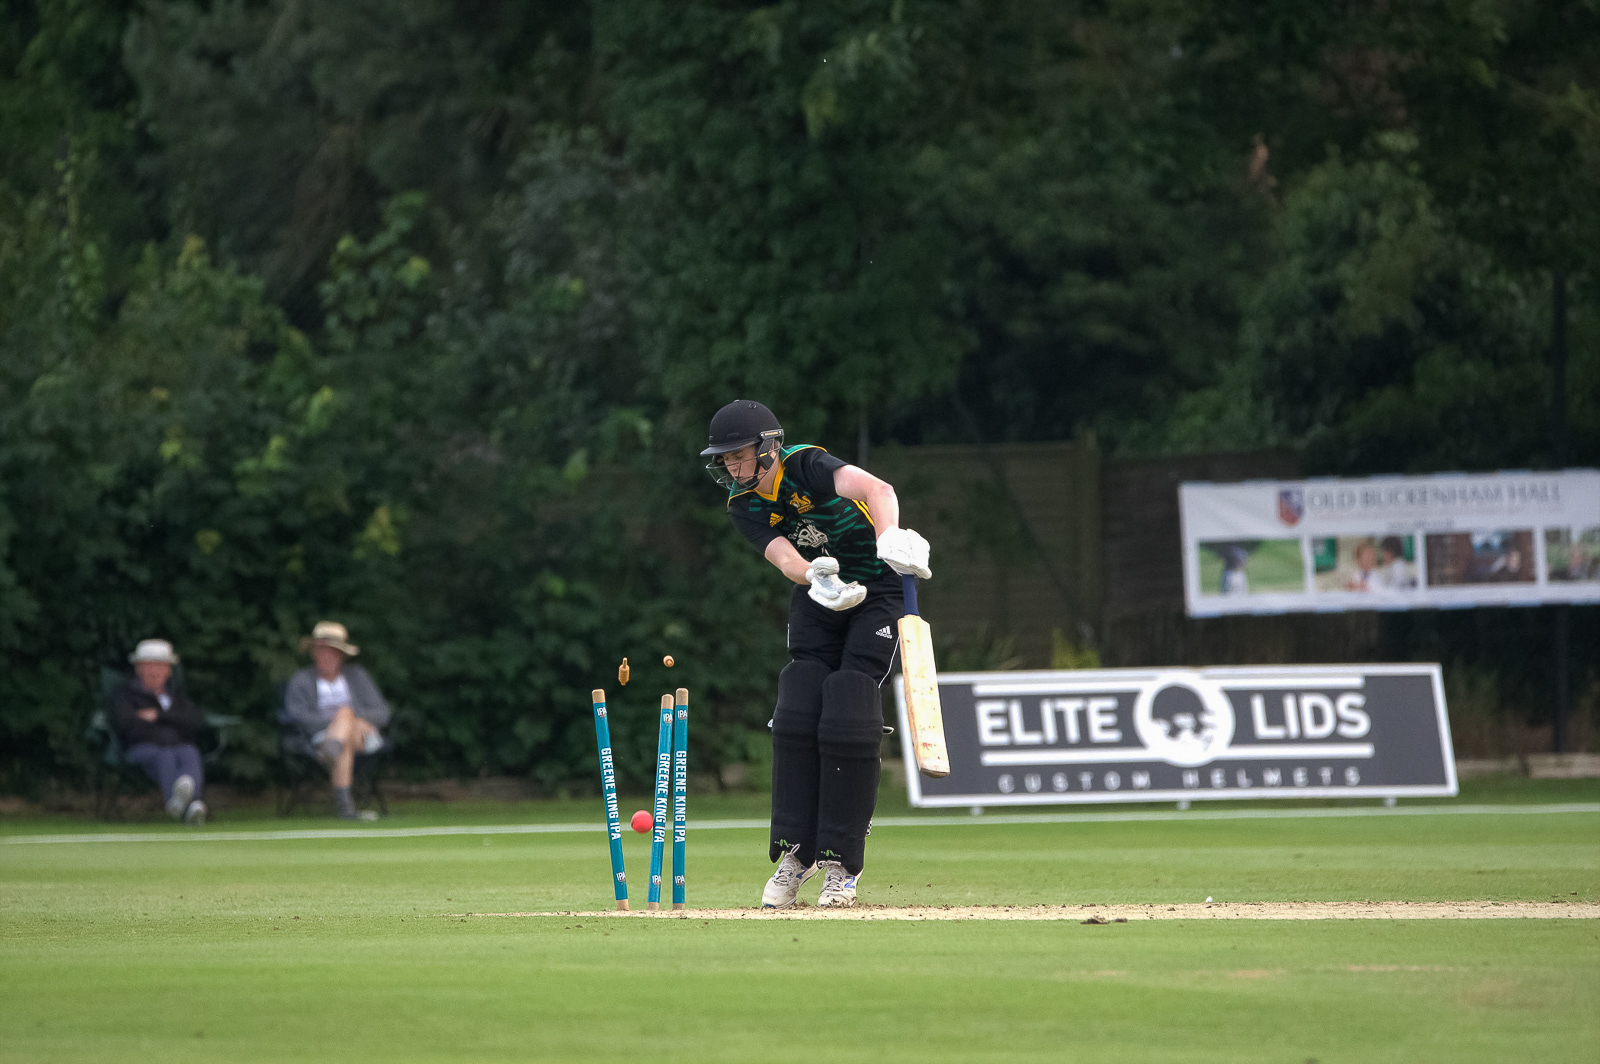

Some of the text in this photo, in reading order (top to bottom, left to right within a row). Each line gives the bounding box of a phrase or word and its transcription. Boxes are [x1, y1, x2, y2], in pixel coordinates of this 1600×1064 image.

[1305, 486, 1356, 512] OLD
[597, 707, 607, 716] IPA
[663, 713, 673, 722] IPA
[677, 710, 688, 718] IPA
[975, 692, 1371, 746] ELITE LIDS
[998, 766, 1360, 793] CUSTOM HELMETS
[601, 747, 621, 840] GREENE KING IPA
[654, 753, 671, 843] GREENE KING IPA
[674, 750, 687, 843] GREENE KING IPA
[616, 872, 626, 881] IPA
[652, 875, 662, 884] IPA
[675, 875, 685, 884] IPA
